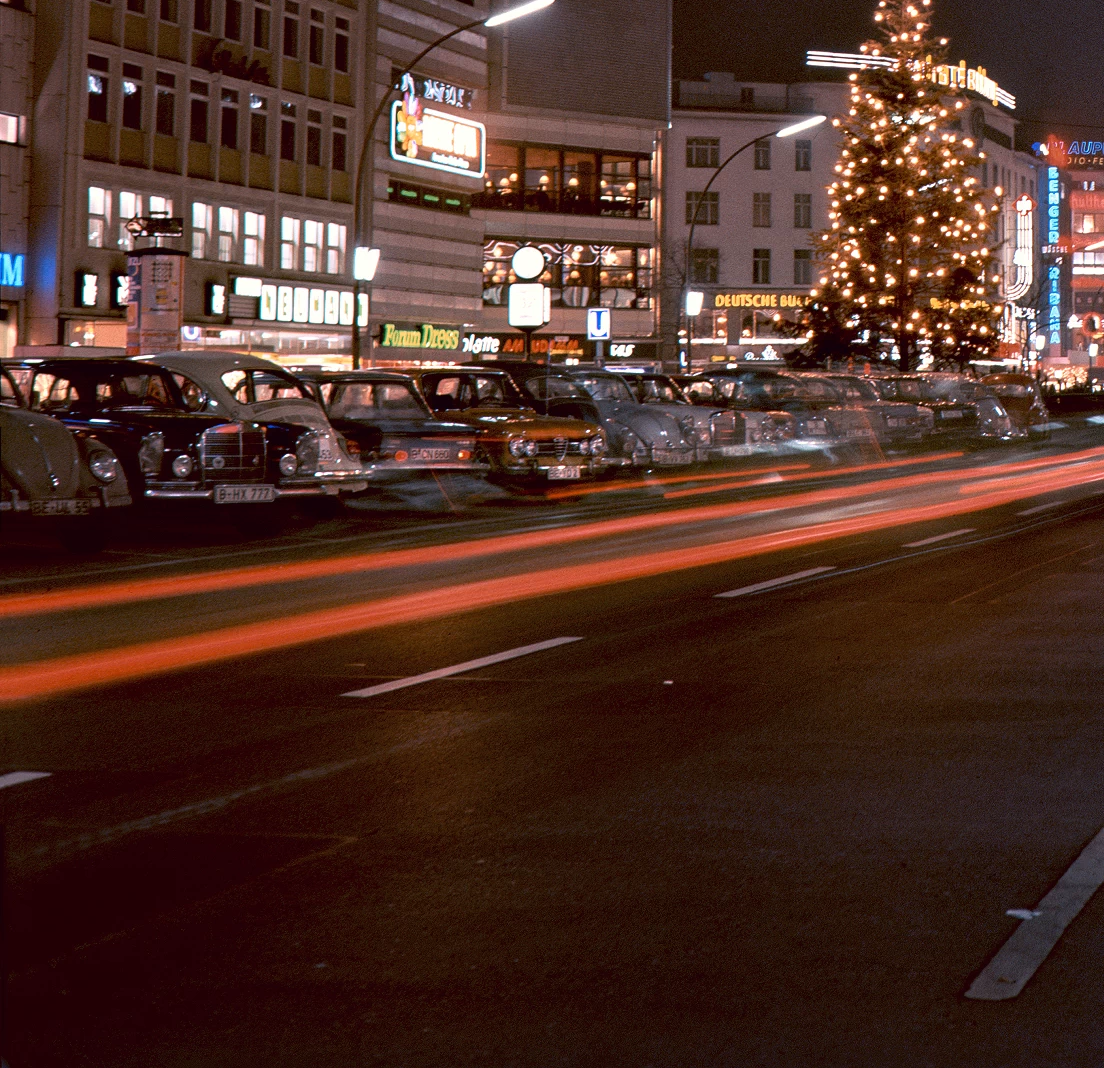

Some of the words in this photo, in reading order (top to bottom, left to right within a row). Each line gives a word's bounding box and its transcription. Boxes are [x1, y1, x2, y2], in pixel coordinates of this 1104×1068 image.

[1047, 166, 1060, 244] BENGER
[0, 252, 25, 287] M
[715, 293, 777, 307] DEUTSCHE
[383, 323, 422, 347] Forum
[422, 324, 459, 350] Dress
[589, 310, 610, 337] U
[219, 488, 247, 500] B-HX
[251, 487, 270, 500] 777
